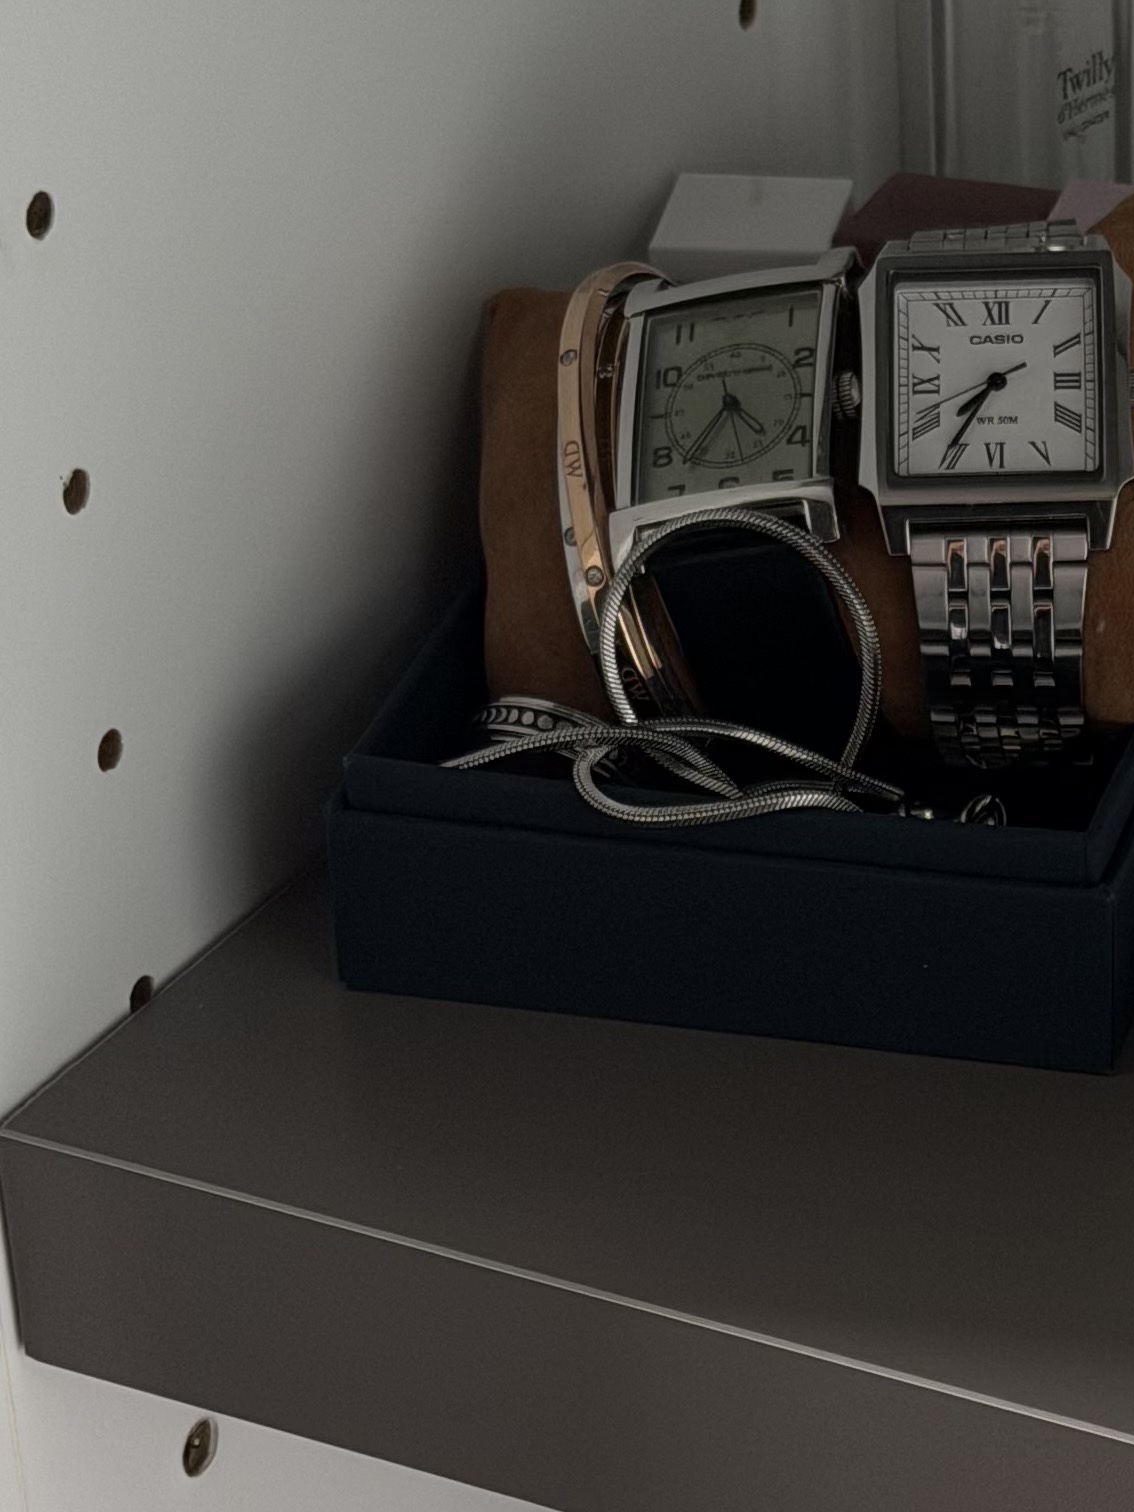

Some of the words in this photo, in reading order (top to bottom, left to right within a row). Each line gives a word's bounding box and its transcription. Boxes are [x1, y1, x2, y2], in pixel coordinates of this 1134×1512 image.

[1056, 50, 1116, 100] Twilly
[982, 301, 1010, 326] XII
[969, 333, 1024, 346] CASIO
[792, 346, 815, 369] 2
[655, 366, 683, 390] 10
[976, 416, 995, 425] WR
[786, 425, 811, 447] 4
[651, 446, 674, 468] 8
